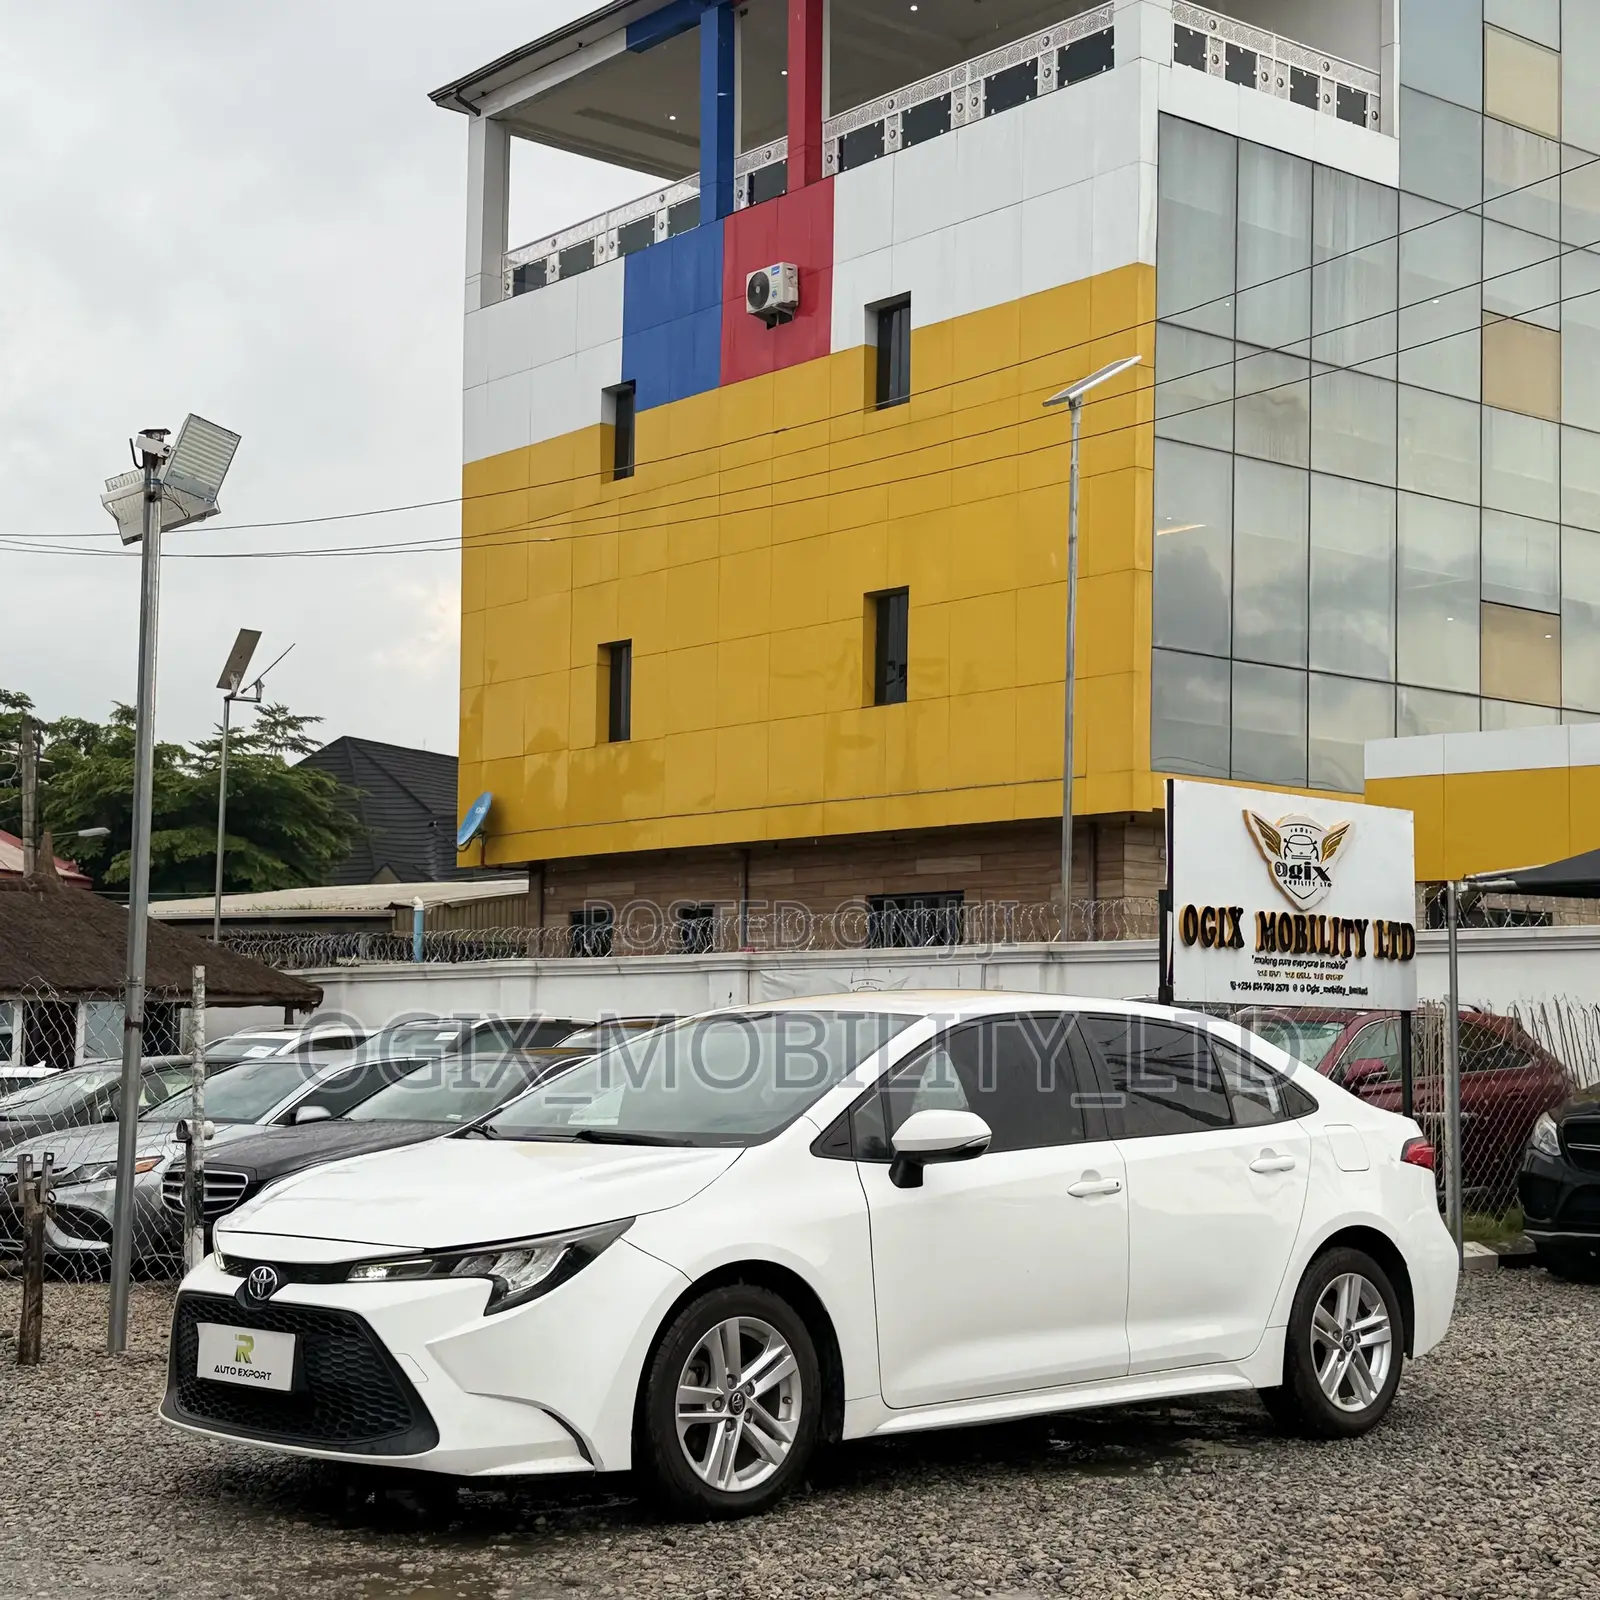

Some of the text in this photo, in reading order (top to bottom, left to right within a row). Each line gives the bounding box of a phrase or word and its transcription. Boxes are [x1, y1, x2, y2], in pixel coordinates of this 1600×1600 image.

[1179, 904, 1415, 961] OGIX MOBILITY LTD
[214, 1365, 272, 1380] AUTO EXPORT
